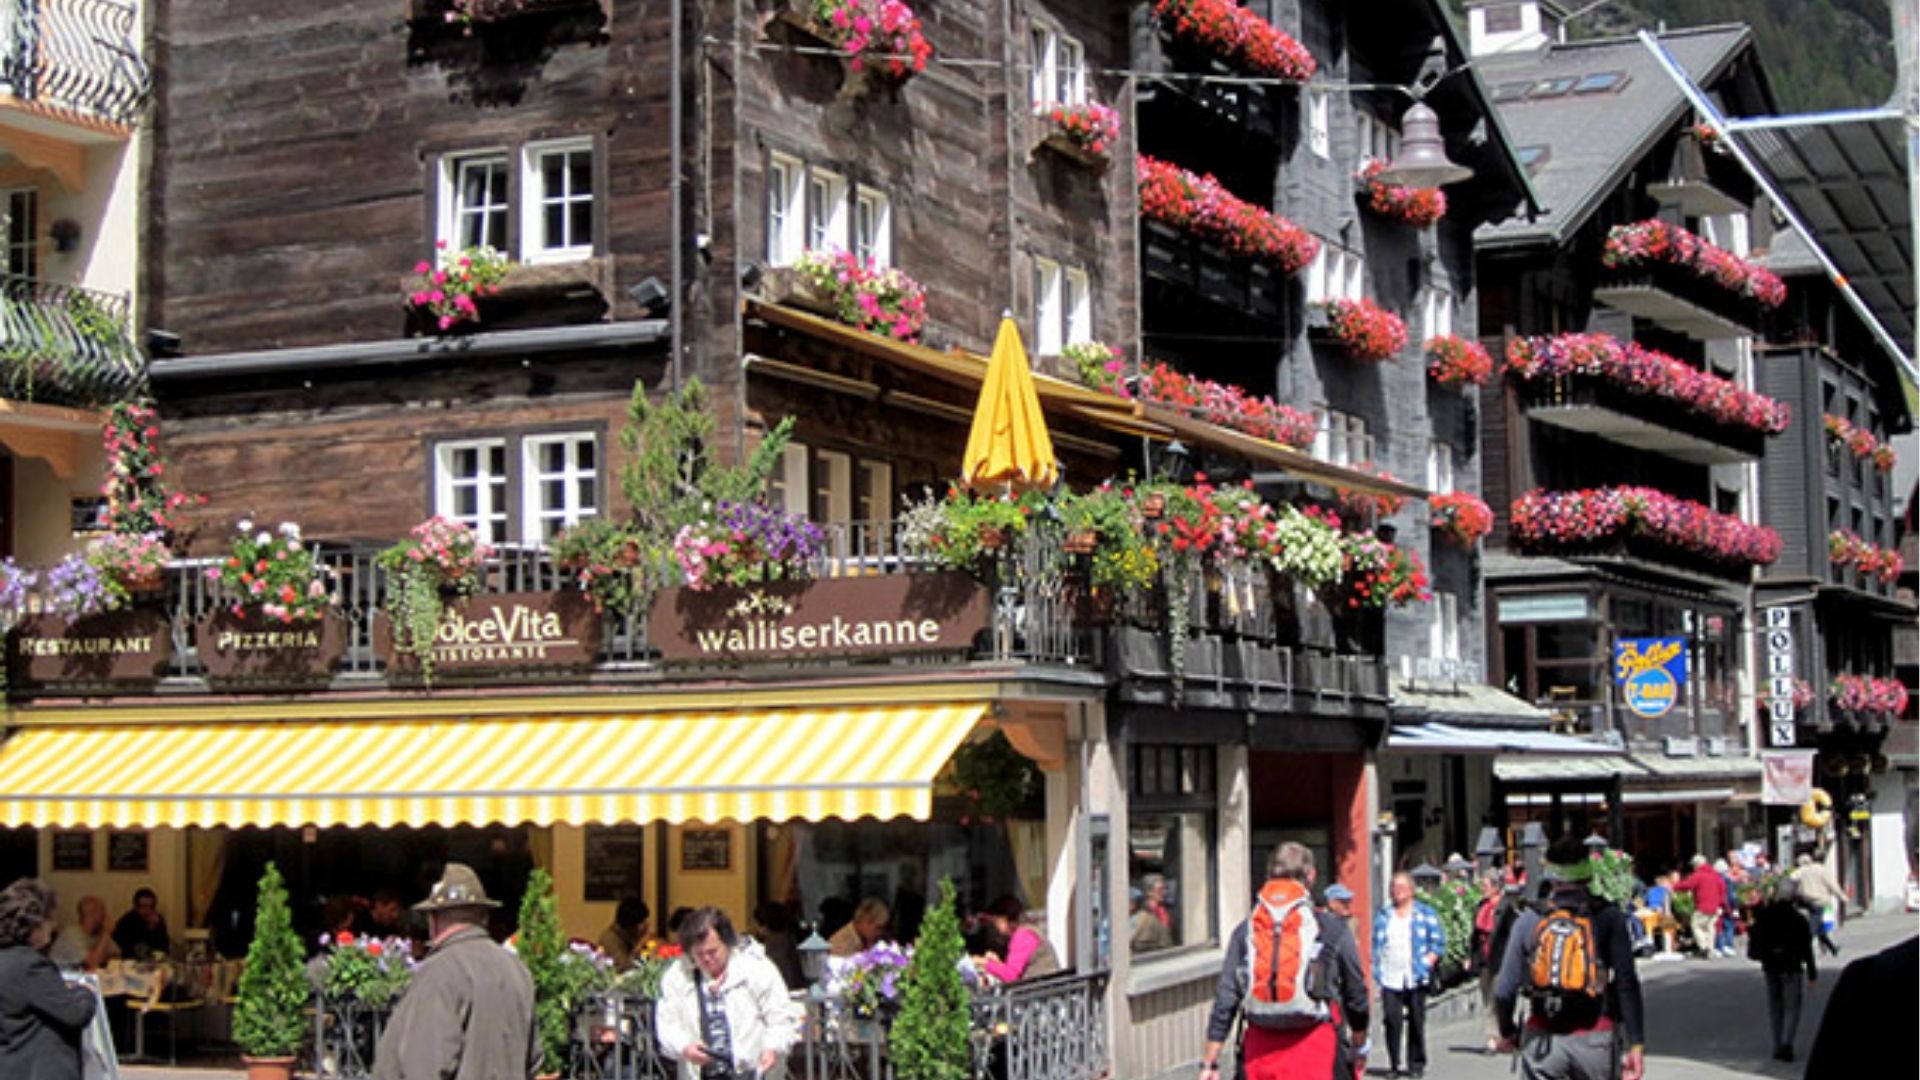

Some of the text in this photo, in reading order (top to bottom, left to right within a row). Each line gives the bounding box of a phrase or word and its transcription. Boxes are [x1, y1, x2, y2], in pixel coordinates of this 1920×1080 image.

[217, 630, 319, 651] PIZZERIA
[427, 603, 563, 645] olceVita
[697, 616, 939, 652] walliserkanne
[19, 635, 152, 656] RESTAURANT
[1772, 609, 1791, 741] POLLUX
